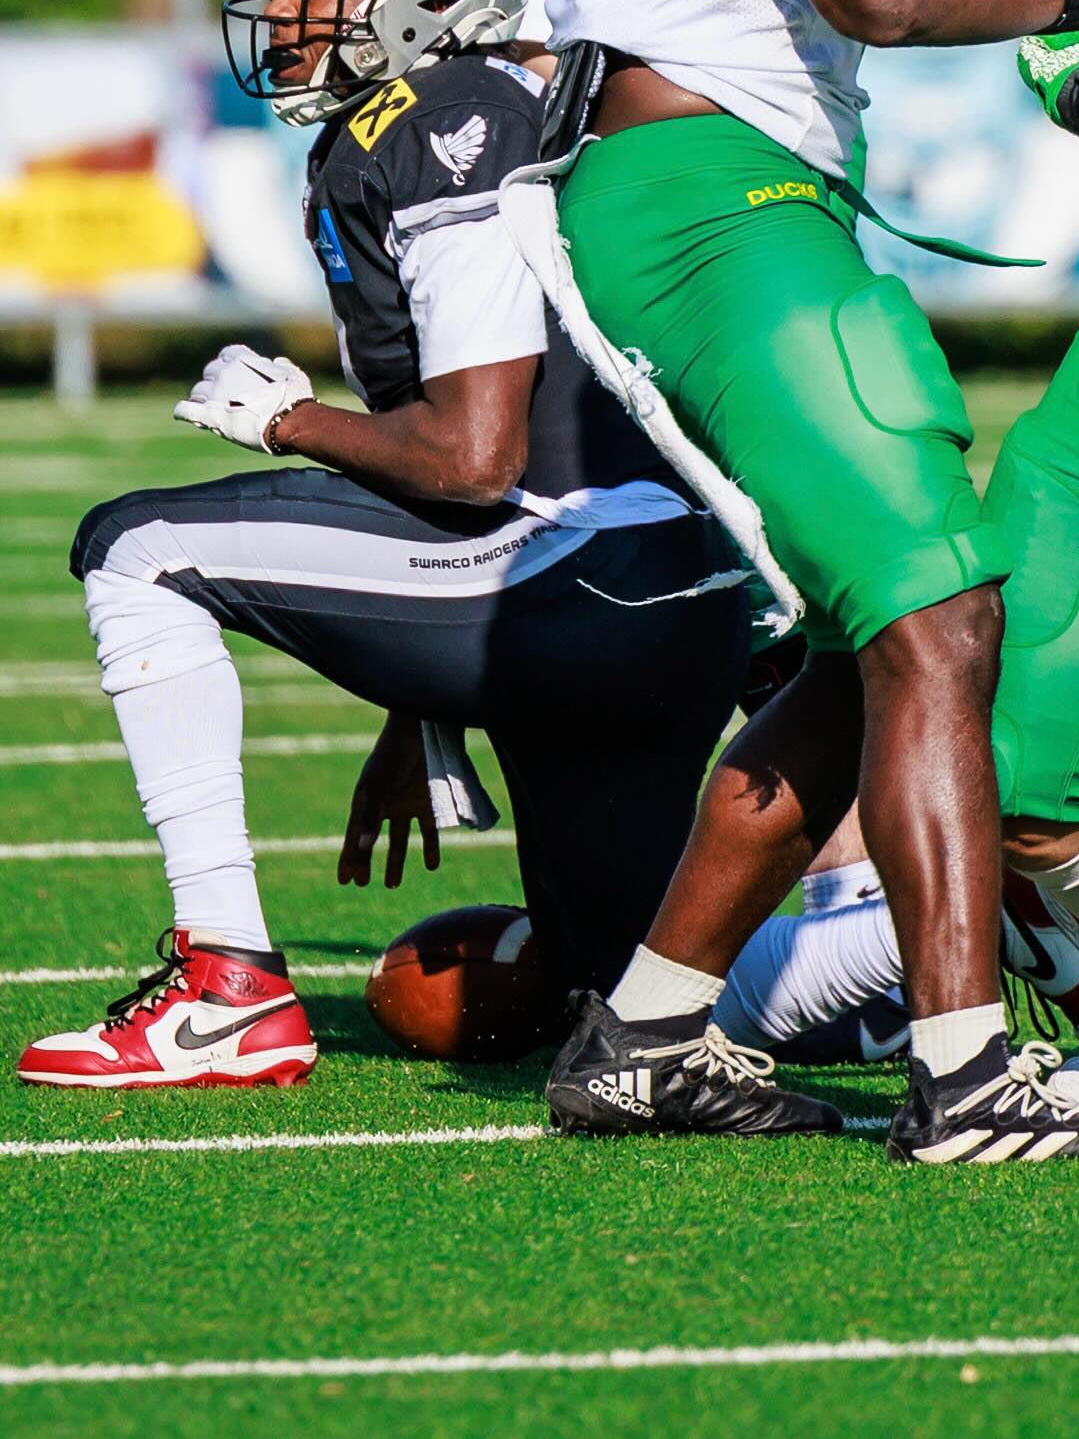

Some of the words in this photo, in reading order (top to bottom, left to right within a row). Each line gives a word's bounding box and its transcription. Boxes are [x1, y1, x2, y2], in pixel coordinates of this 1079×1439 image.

[746, 181, 818, 206] DUCKS
[409, 557, 471, 570] SWARCO
[474, 534, 529, 566] RAIDERS
[587, 1078, 656, 1118] adidas
